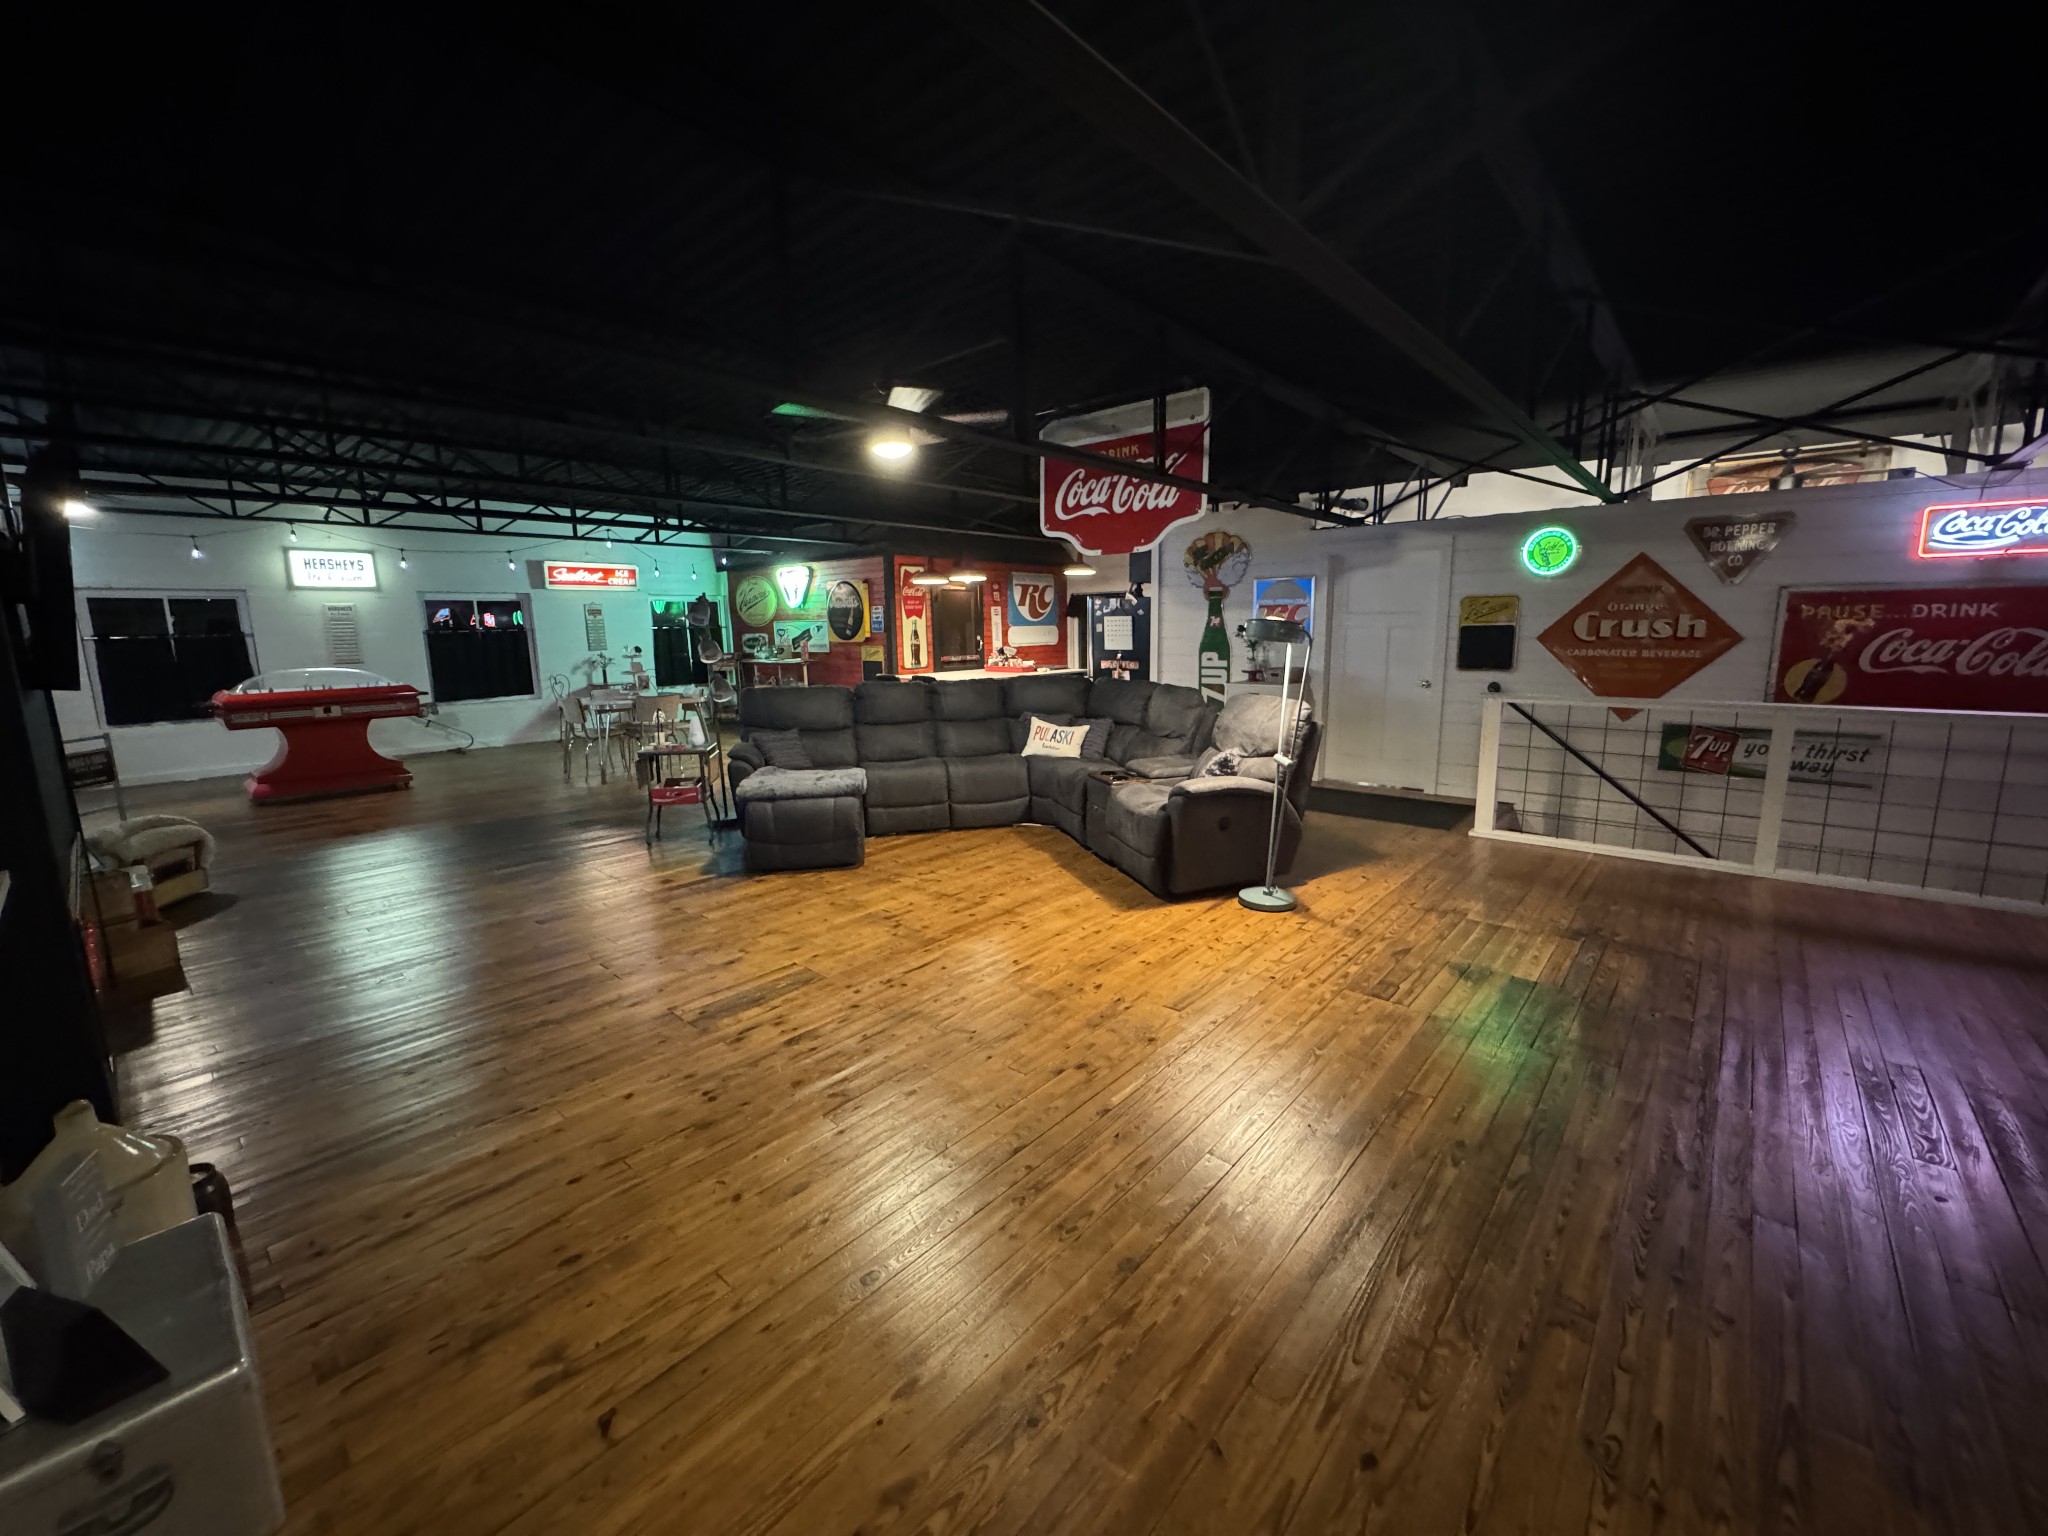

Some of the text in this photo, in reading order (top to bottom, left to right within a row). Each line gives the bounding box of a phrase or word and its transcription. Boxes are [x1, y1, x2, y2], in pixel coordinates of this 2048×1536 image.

[1100, 444, 1139, 459] RINK
[1724, 522, 1777, 537] PEPPER
[614, 569, 629, 577] ICE
[1014, 583, 1054, 620] RC
[1607, 602, 1664, 614] Orange
[1911, 602, 1999, 618] DRINK
[1572, 611, 1707, 642] Crush
[1033, 725, 1075, 746] PULASKI
[1805, 743, 1871, 762] thirst
[1790, 761, 1834, 778] way
